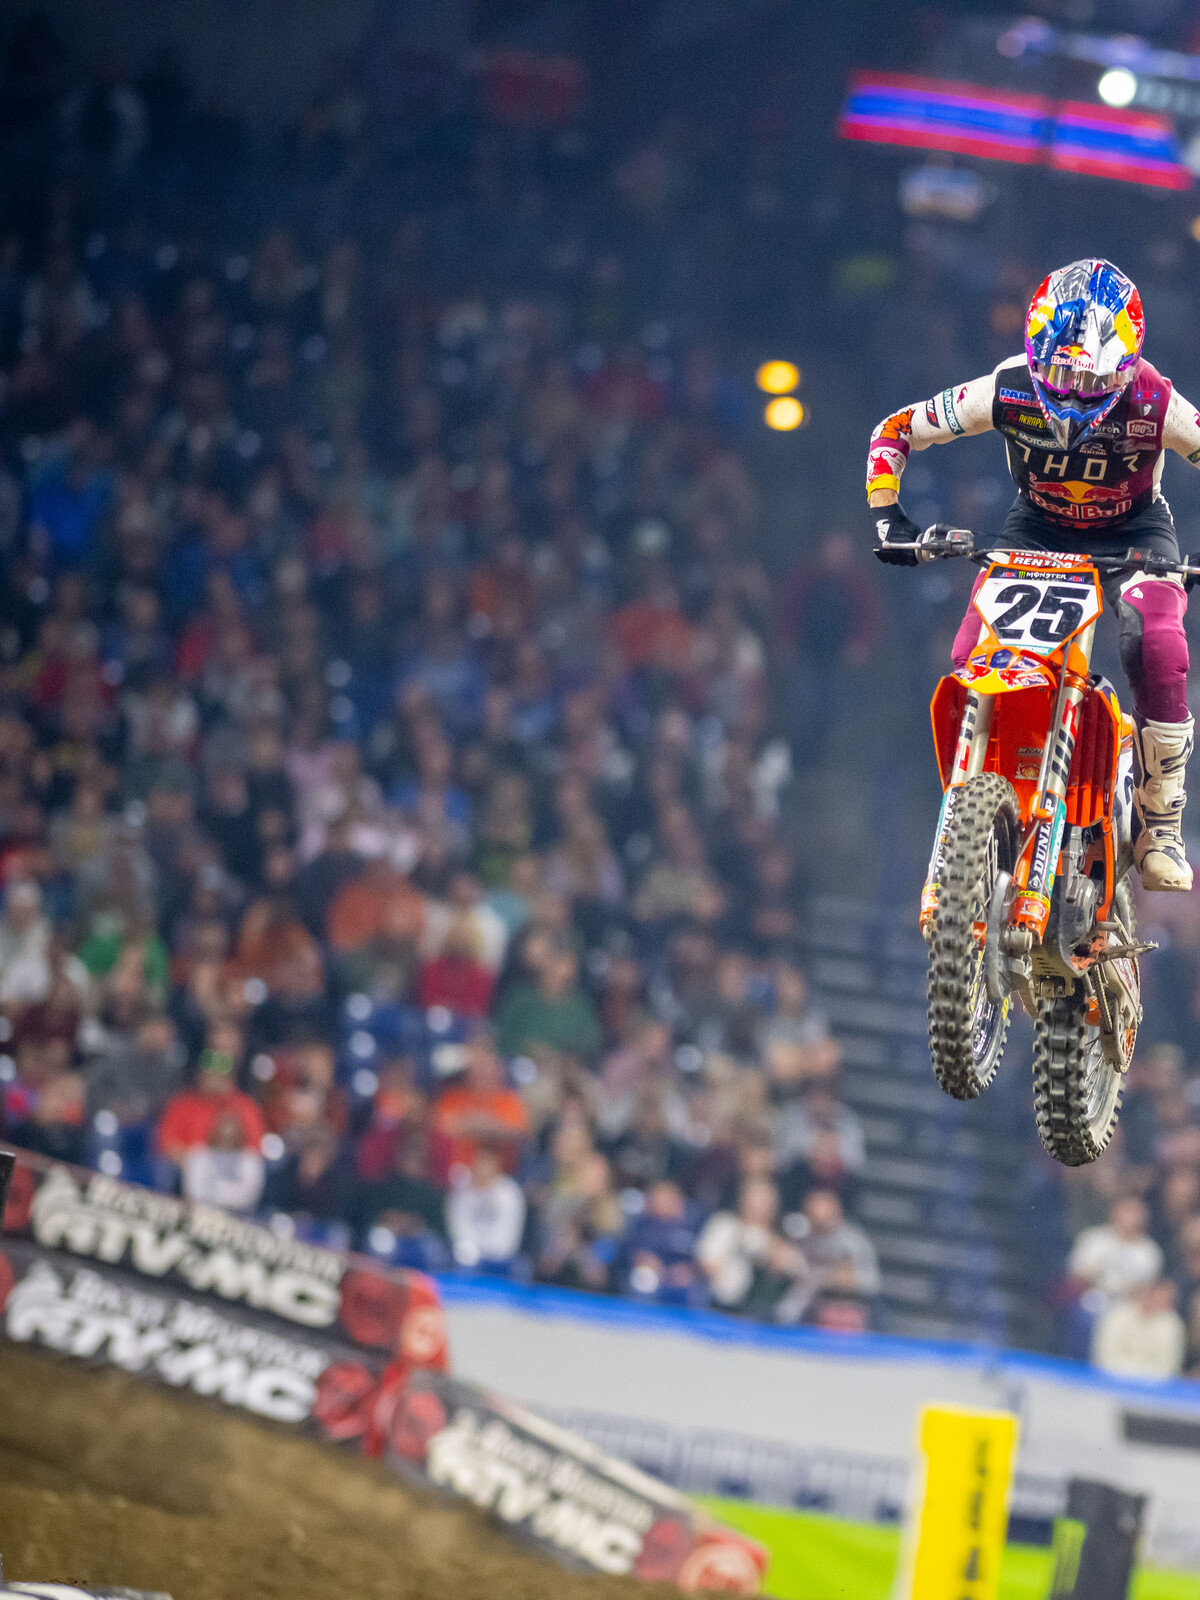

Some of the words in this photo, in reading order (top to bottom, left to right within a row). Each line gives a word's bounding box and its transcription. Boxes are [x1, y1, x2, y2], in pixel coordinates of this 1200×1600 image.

[1051, 355, 1073, 366] Red
[1073, 357, 1094, 370] Bull
[943, 389, 961, 432] MOTOREX
[1019, 432, 1063, 448] MOTOREX
[1131, 424, 1154, 435] 100%
[1029, 490, 1080, 519] Red
[1081, 499, 1132, 520] Bull
[1026, 571, 1067, 580] MONSTER
[991, 584, 1091, 643] 25
[1033, 798, 1056, 875] DUNLP
[1050, 815, 1066, 875] MOTOREX
